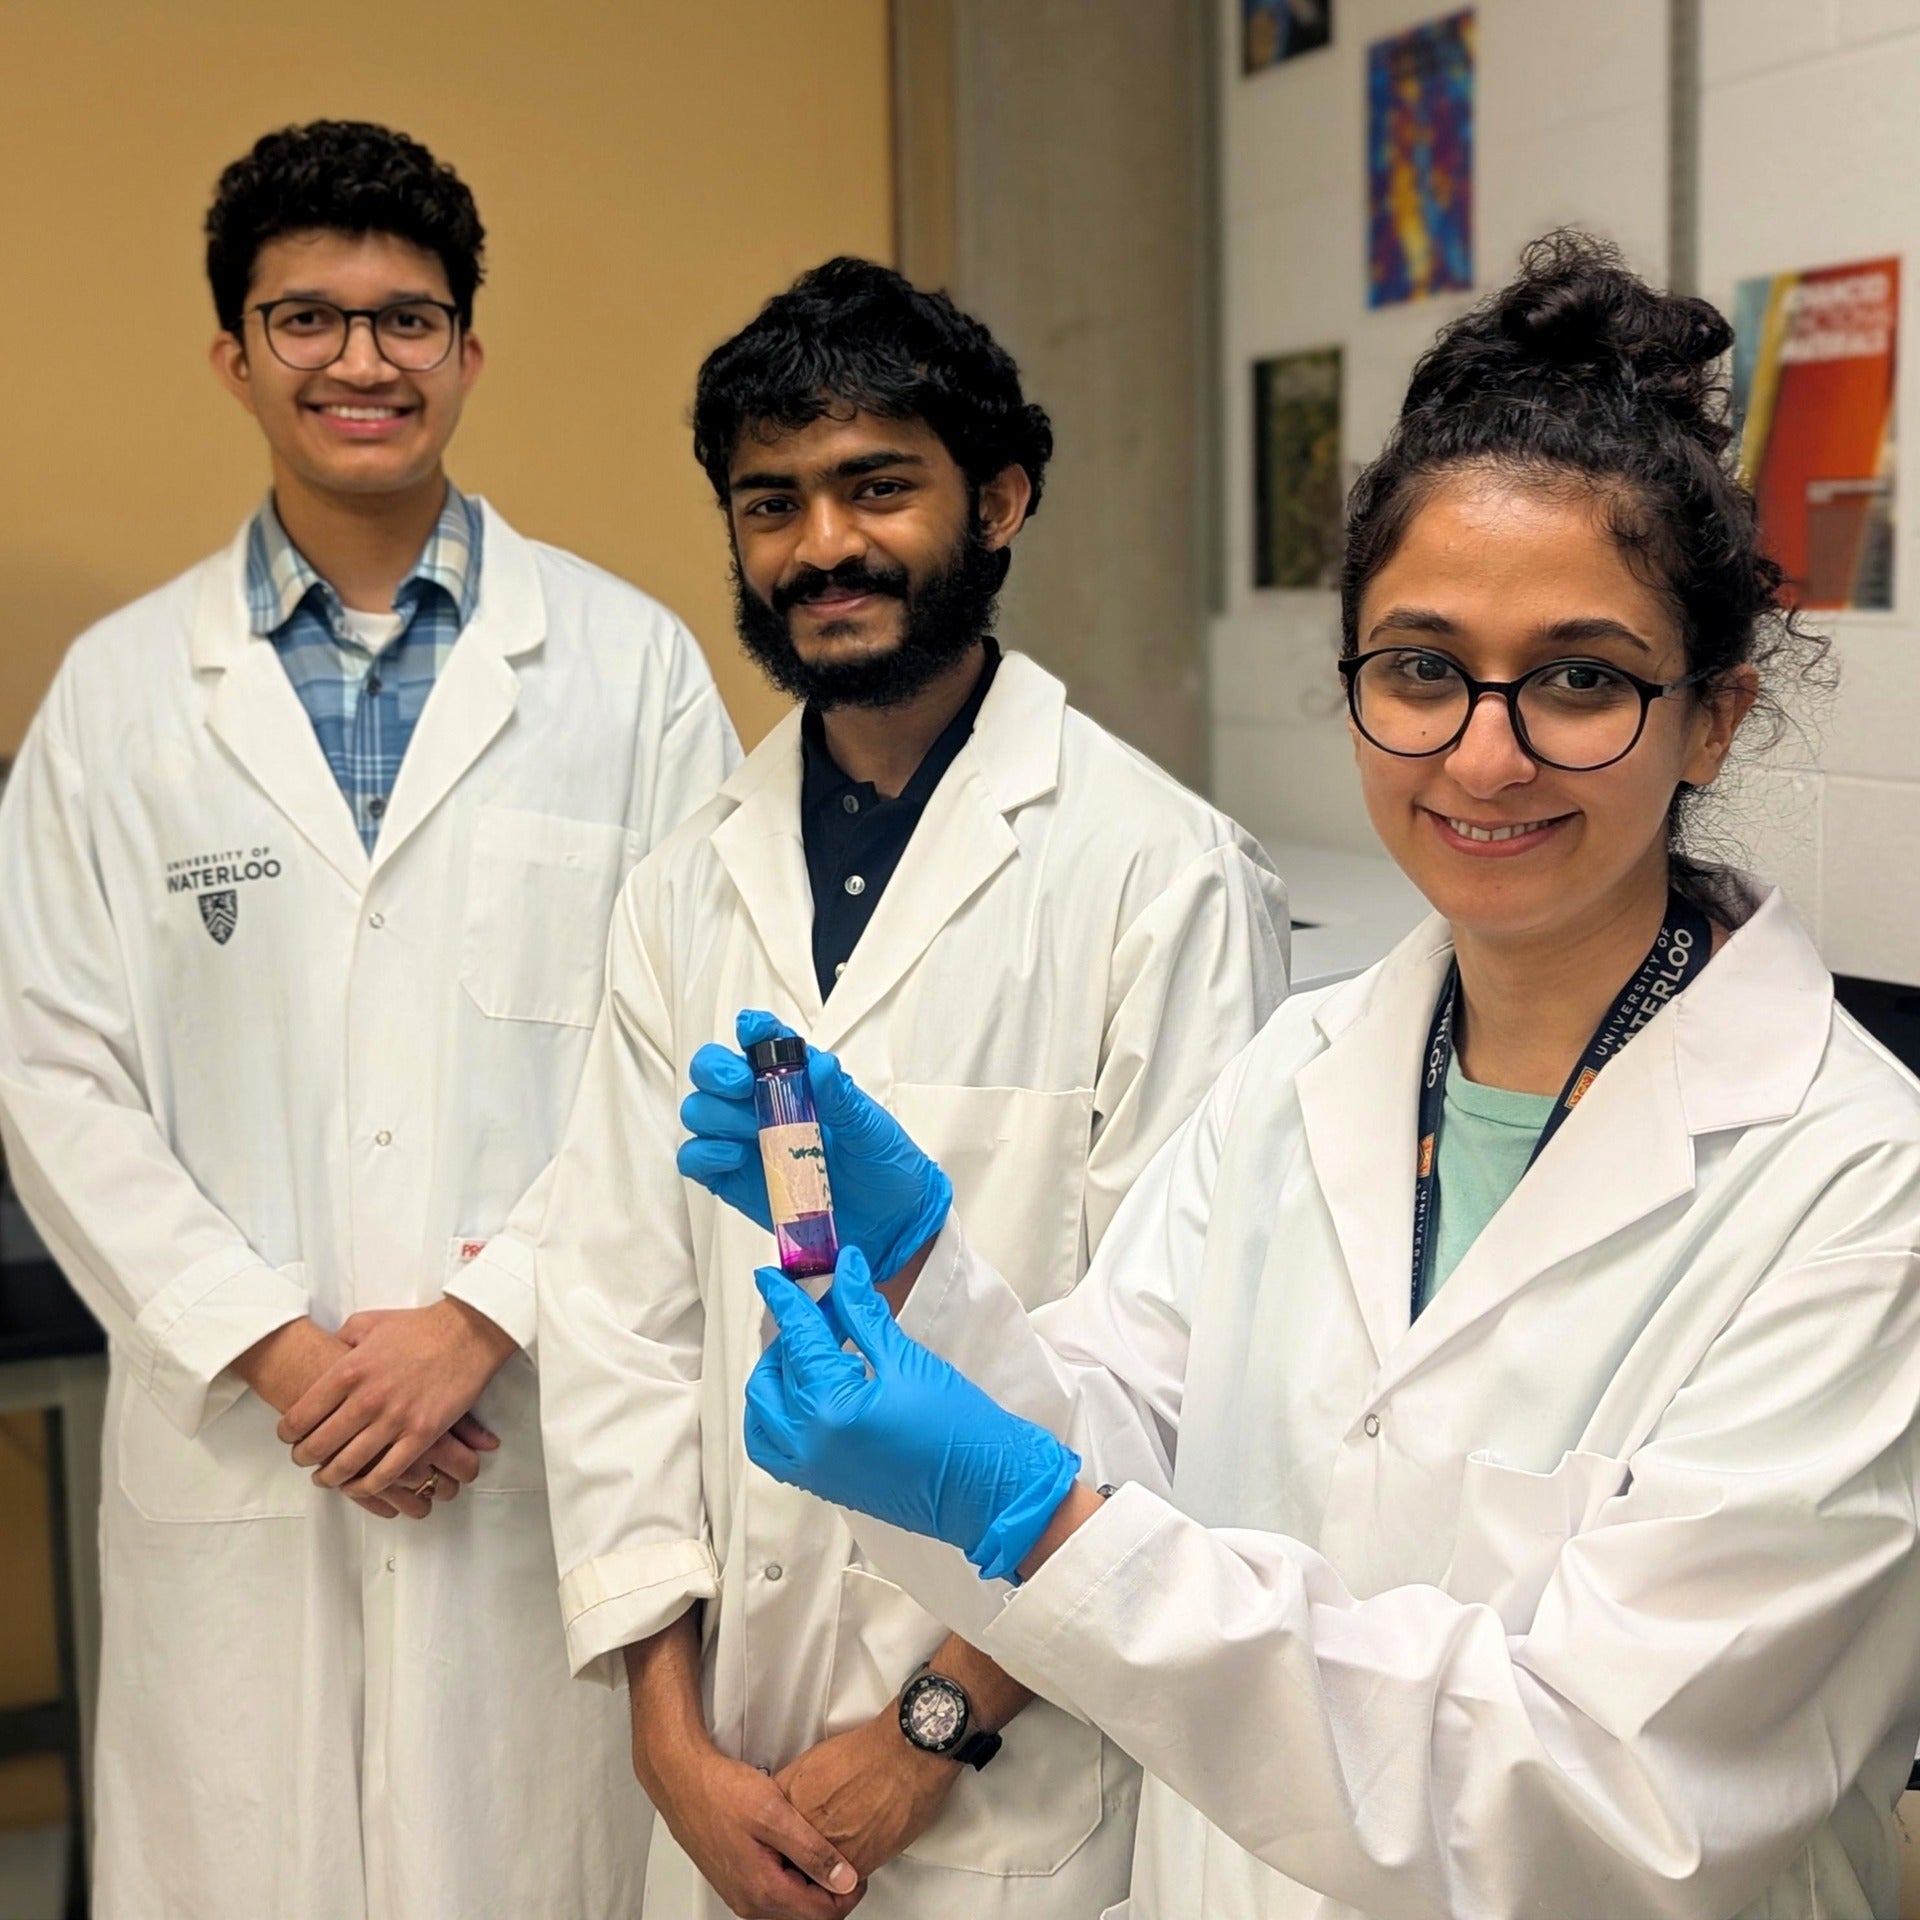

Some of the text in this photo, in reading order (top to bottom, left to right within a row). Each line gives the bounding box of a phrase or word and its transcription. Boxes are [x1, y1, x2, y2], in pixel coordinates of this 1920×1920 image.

[166, 859, 281, 893] WATERLOO
[167, 846, 270, 872] UNIVERSITY OF
[1595, 927, 1672, 1056] UNIVERSITY OF
